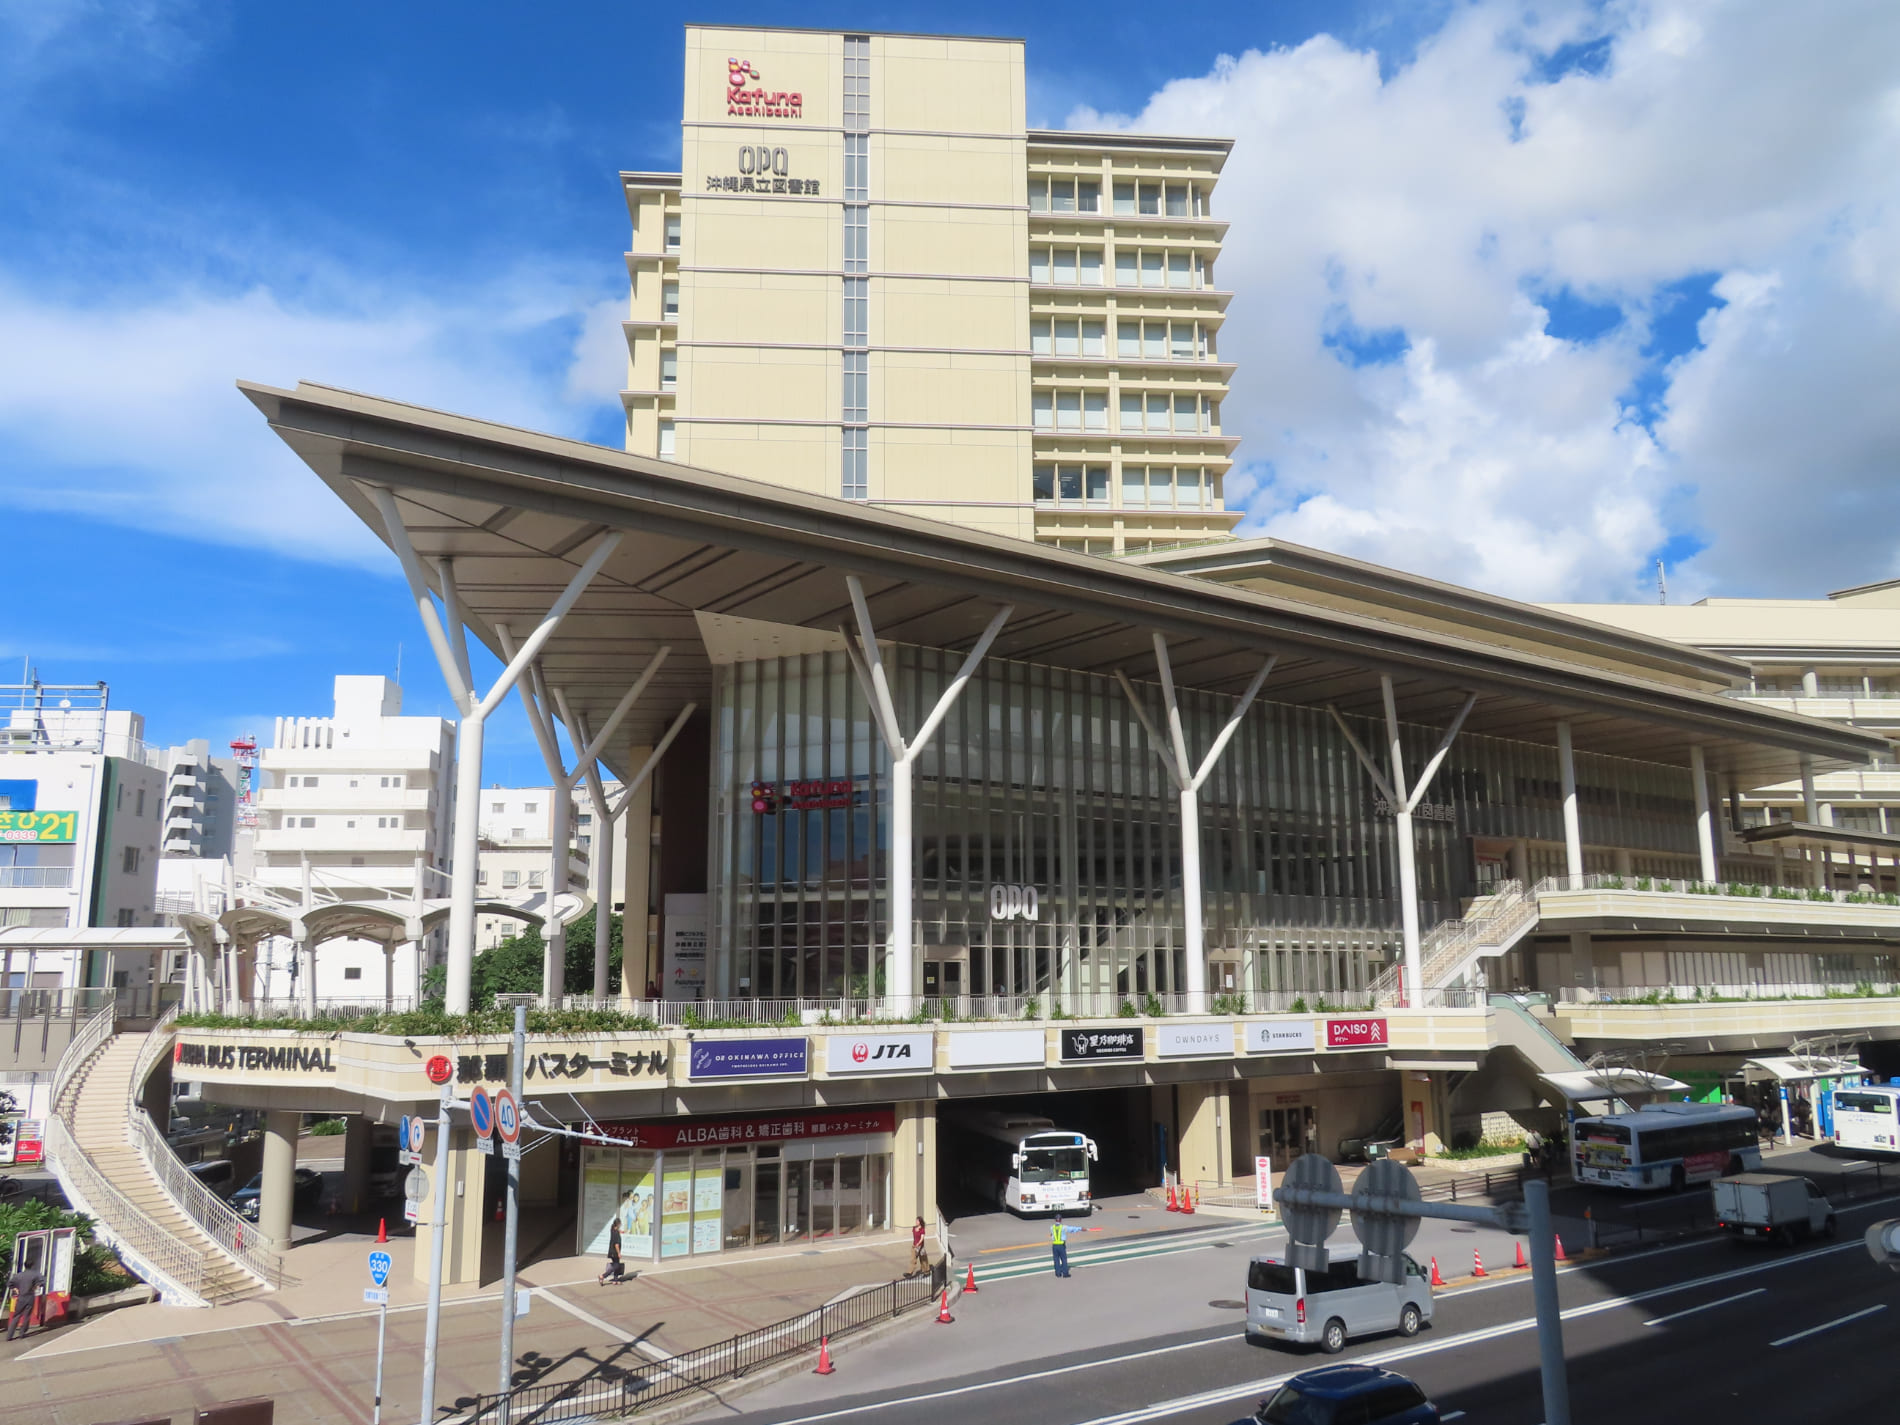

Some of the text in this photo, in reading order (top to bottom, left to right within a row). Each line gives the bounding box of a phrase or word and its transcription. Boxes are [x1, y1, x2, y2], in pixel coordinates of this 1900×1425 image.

[727, 105, 802, 118] Asahibashi
[706, 176, 820, 195] 沖縄県立図書館
[1334, 1023, 1368, 1035] DAISO
[1175, 1034, 1220, 1044] OWNDAYS
[207, 1045, 236, 1070] BUS
[237, 1046, 336, 1073] TERMINAL
[728, 1053, 769, 1061] OKINAWA
[773, 1052, 804, 1060] OFFICE
[871, 1044, 911, 1060] JTA
[501, 1104, 515, 1129] 40
[745, 1124, 755, 1138] &
[758, 1121, 805, 1137] 矯正歯科
[371, 1259, 388, 1273] 330
